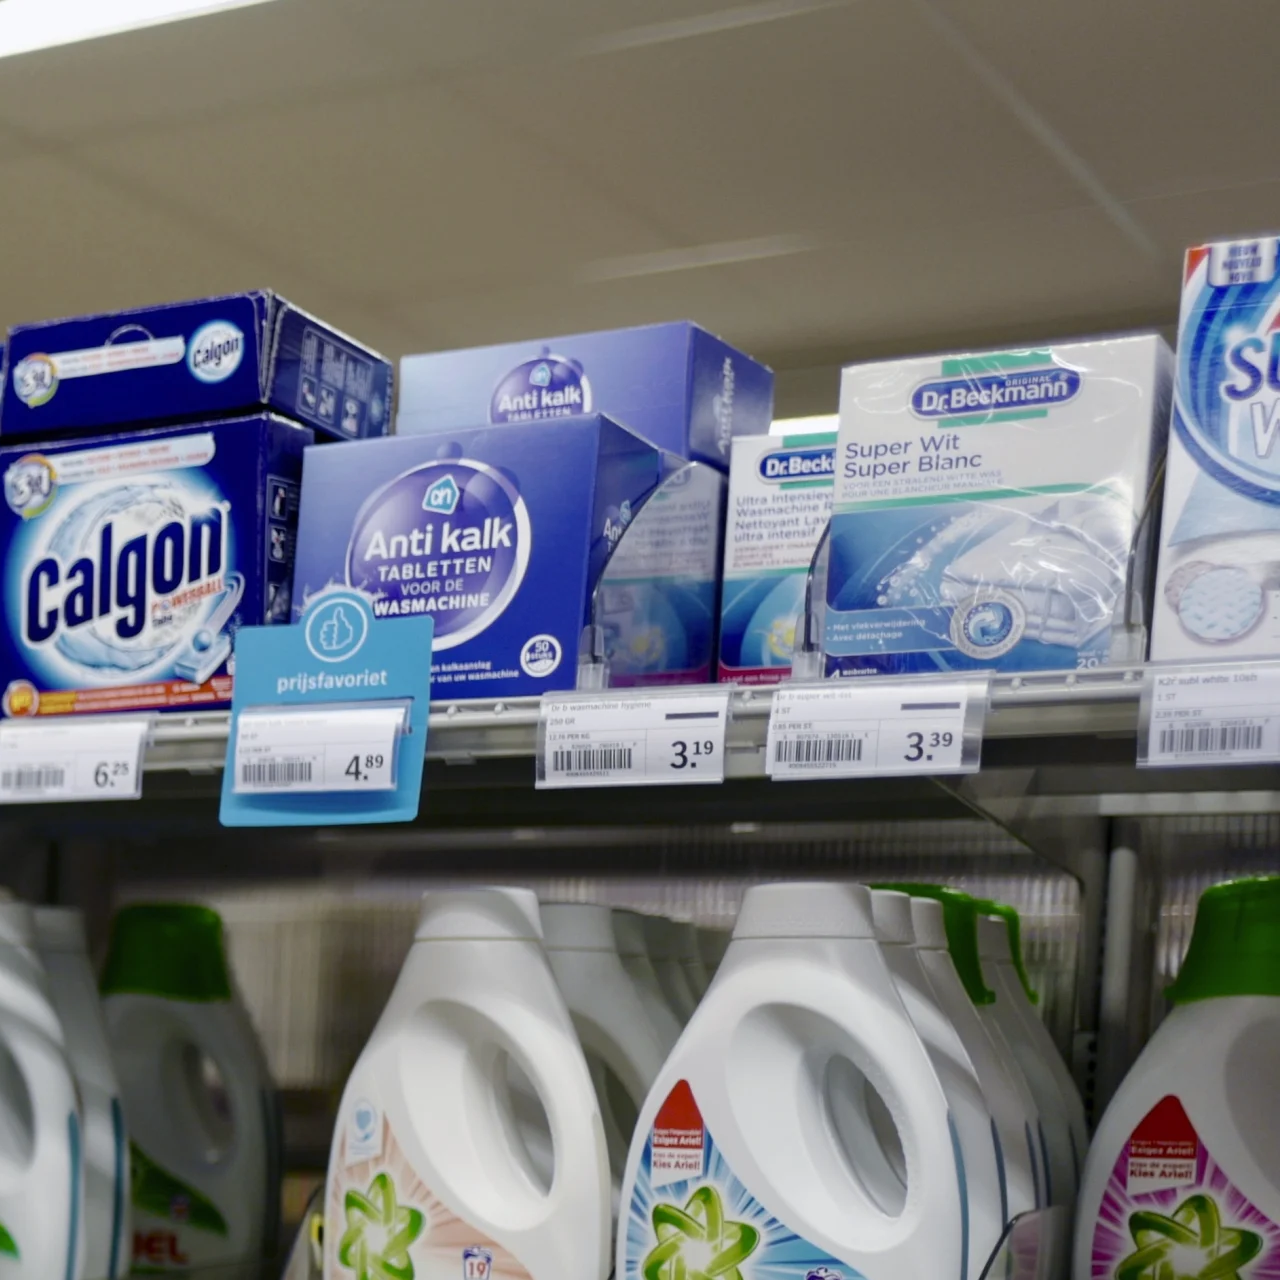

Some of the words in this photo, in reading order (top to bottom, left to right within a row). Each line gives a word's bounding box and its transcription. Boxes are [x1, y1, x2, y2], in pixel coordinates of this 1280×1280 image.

[192, 335, 242, 371] Calgon
[1005, 376, 1052, 387] ORIGINAL
[499, 393, 538, 412] Anti
[541, 387, 582, 407] kalk
[921, 379, 1069, 413] Dr.Beckmann
[845, 439, 913, 462] Super
[920, 434, 961, 453] Wit
[844, 459, 911, 481] Super
[918, 453, 983, 474] Blanc
[841, 488, 868, 499] POUR
[870, 487, 891, 497] UNE
[842, 480, 871, 491] VOOR
[736, 503, 821, 519] Wasmachine
[734, 531, 764, 543] ultra
[767, 527, 816, 540] intensif
[735, 517, 800, 531] Nettoyant
[365, 524, 433, 562] Anti
[442, 516, 513, 553] kalk
[27, 506, 223, 644] Calgon
[378, 555, 492, 583] TABLETTEN
[400, 581, 441, 597] VOOR
[444, 578, 464, 592] DE
[373, 593, 490, 618] WASMACHINE
[534, 641, 550, 653] 50
[833, 632, 854, 642] Avec
[276, 669, 388, 695] prijsfavoriet
[468, 669, 520, 681] wasmachine
[670, 740, 714, 770] 3.19
[903, 731, 954, 762] 3.39
[345, 754, 385, 782] 4.89
[653, 1160, 672, 1169] Kies
[673, 1160, 700, 1171] Ariel!
[1130, 1168, 1155, 1178] Kies
[1159, 1169, 1193, 1179] Ariel!
[467, 1260, 487, 1279] 19
